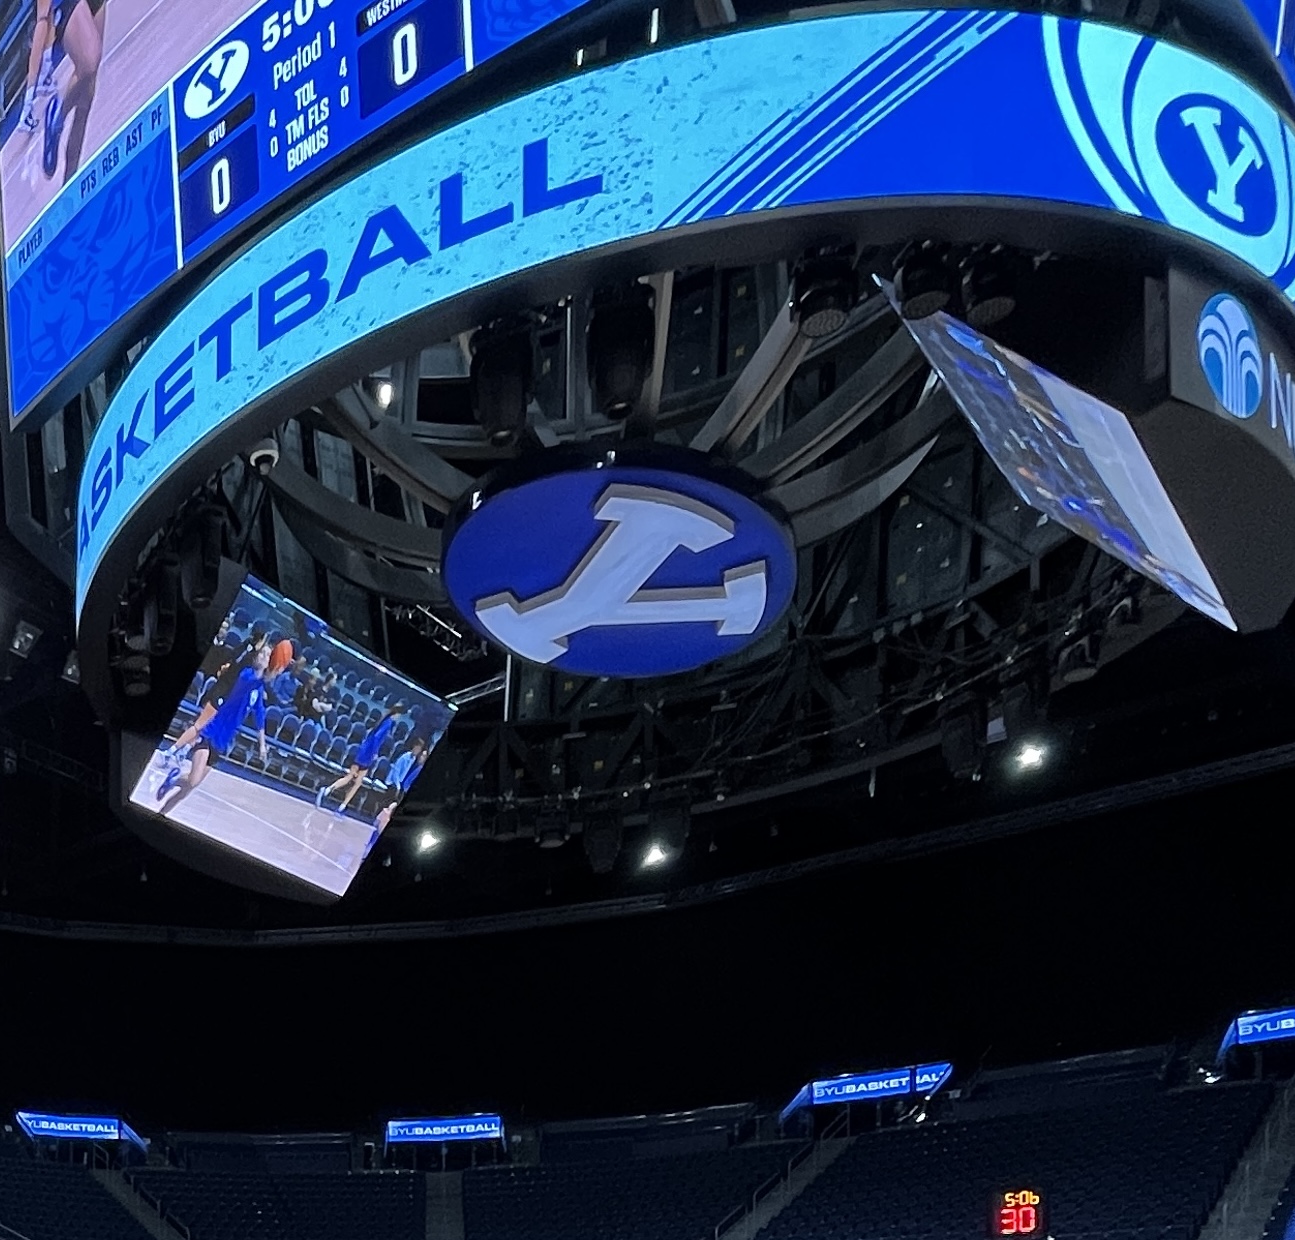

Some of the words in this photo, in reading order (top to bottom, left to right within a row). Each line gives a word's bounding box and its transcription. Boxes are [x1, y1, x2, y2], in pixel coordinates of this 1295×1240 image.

[262, 0, 334, 52] 5:0
[273, 31, 322, 90] Period
[328, 21, 336, 49] 1
[339, 56, 348, 78] 4
[392, 23, 418, 86] 0
[294, 79, 317, 111] TOL
[340, 85, 349, 108] 0
[208, 120, 226, 148] BYU
[269, 108, 277, 128] 4
[285, 114, 305, 145] TM
[308, 97, 329, 130] FLS
[80, 170, 97, 199] PTS
[102, 149, 120, 177] REB
[125, 122, 143, 156] AST
[151, 104, 163, 131] PF
[270, 136, 279, 158] 0
[287, 125, 329, 172] BONUS
[210, 158, 231, 214] 0
[17, 228, 43, 269] PLAYER
[1269, 352, 1295, 450] N
[1000, 1206, 1036, 1234] 30
